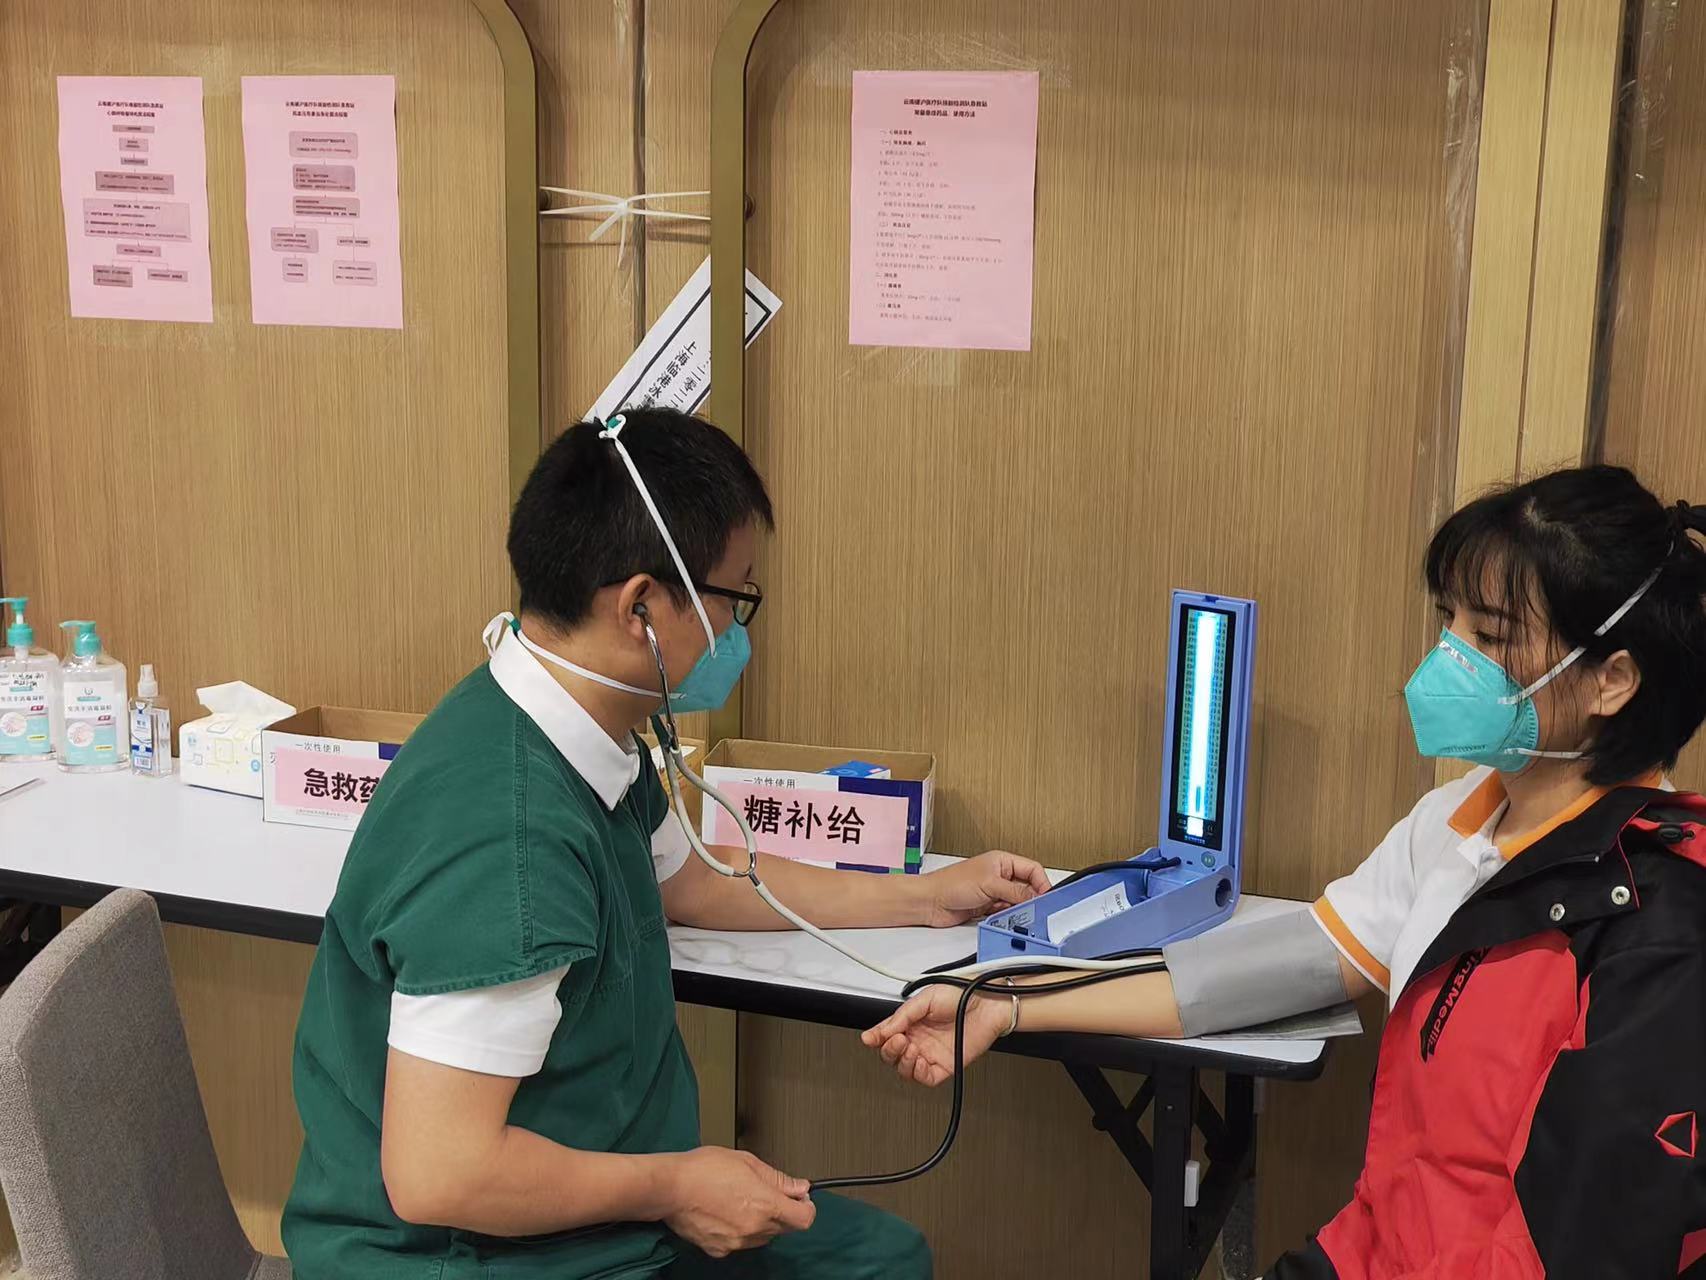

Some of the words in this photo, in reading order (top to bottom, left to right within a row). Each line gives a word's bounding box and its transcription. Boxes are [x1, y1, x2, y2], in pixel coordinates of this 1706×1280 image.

[295, 742, 341, 753] 一次性使用
[304, 768, 380, 804] 急救药
[743, 777, 796, 789] 一次性使用
[743, 794, 865, 845] 糖补给
